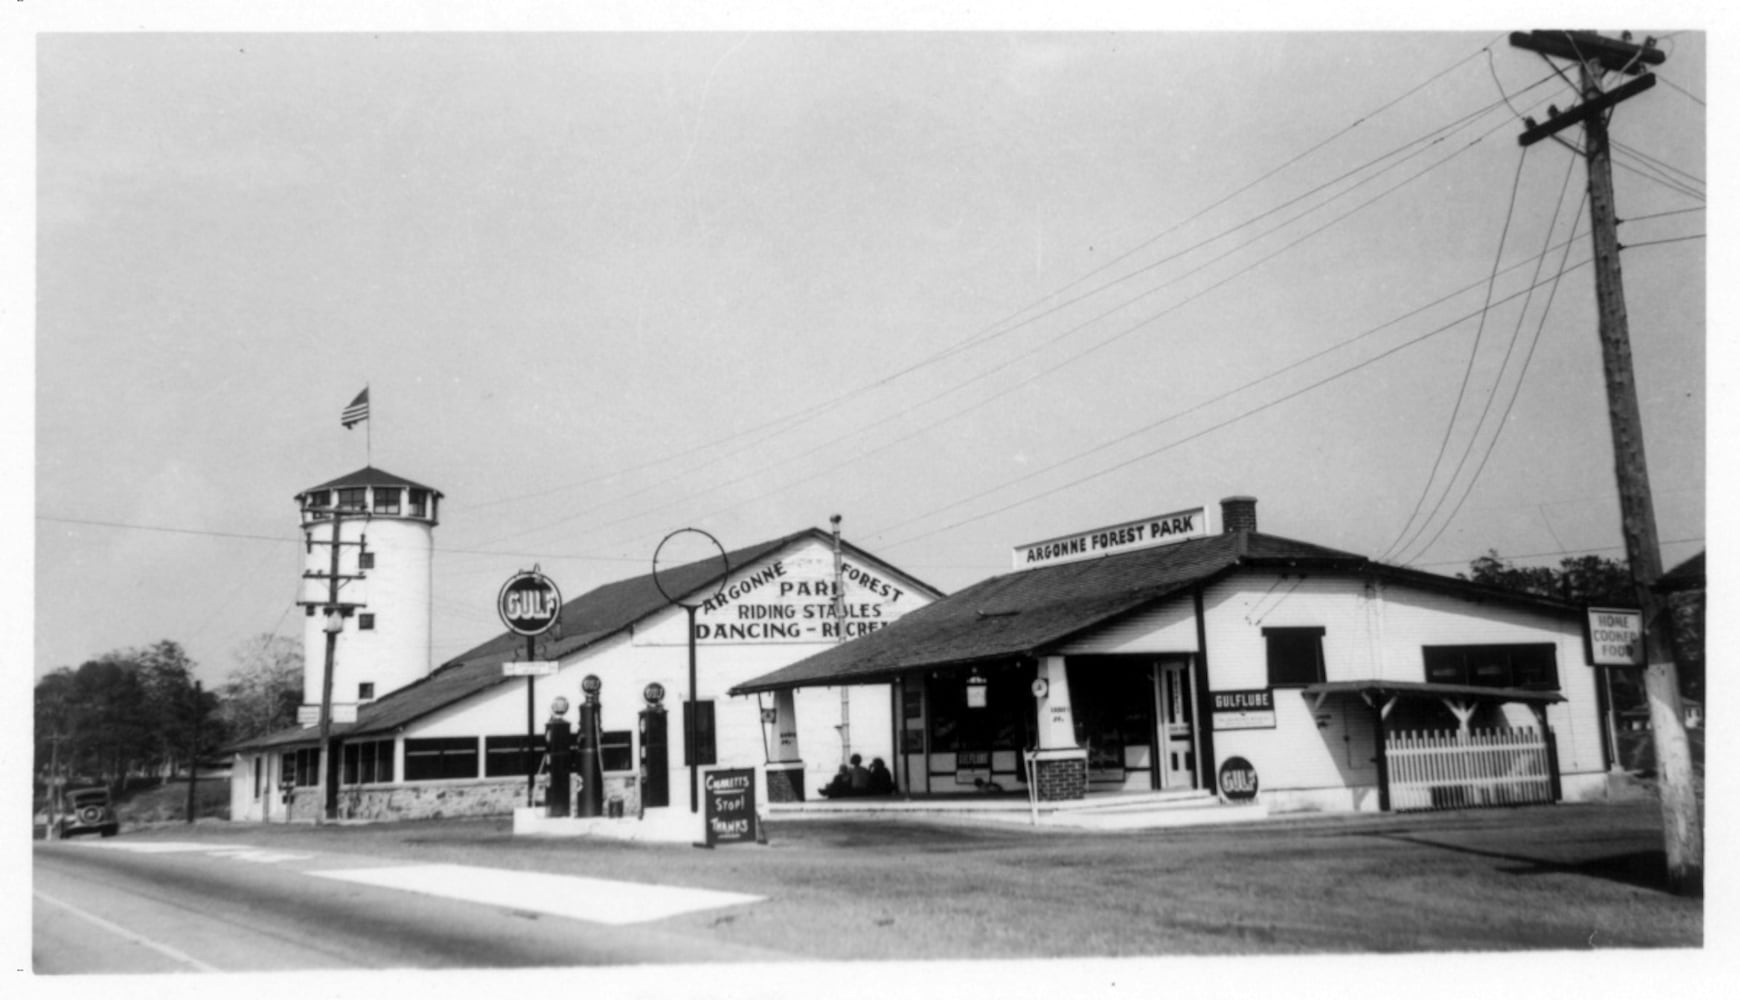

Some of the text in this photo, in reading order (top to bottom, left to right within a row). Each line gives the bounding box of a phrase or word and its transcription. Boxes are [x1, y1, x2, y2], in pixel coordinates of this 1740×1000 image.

[1026, 515, 1194, 563] ARGONNE FOREST PARK
[703, 561, 904, 615] ARGONNE FOREST
[506, 590, 556, 620] GULF
[738, 604, 796, 620] RIDING
[695, 622, 801, 639] DANCING
[1598, 615, 1630, 629] HOME
[1592, 629, 1639, 643] COOKED
[1215, 693, 1270, 708] GULFLUBE
[1221, 768, 1257, 794] GULF
